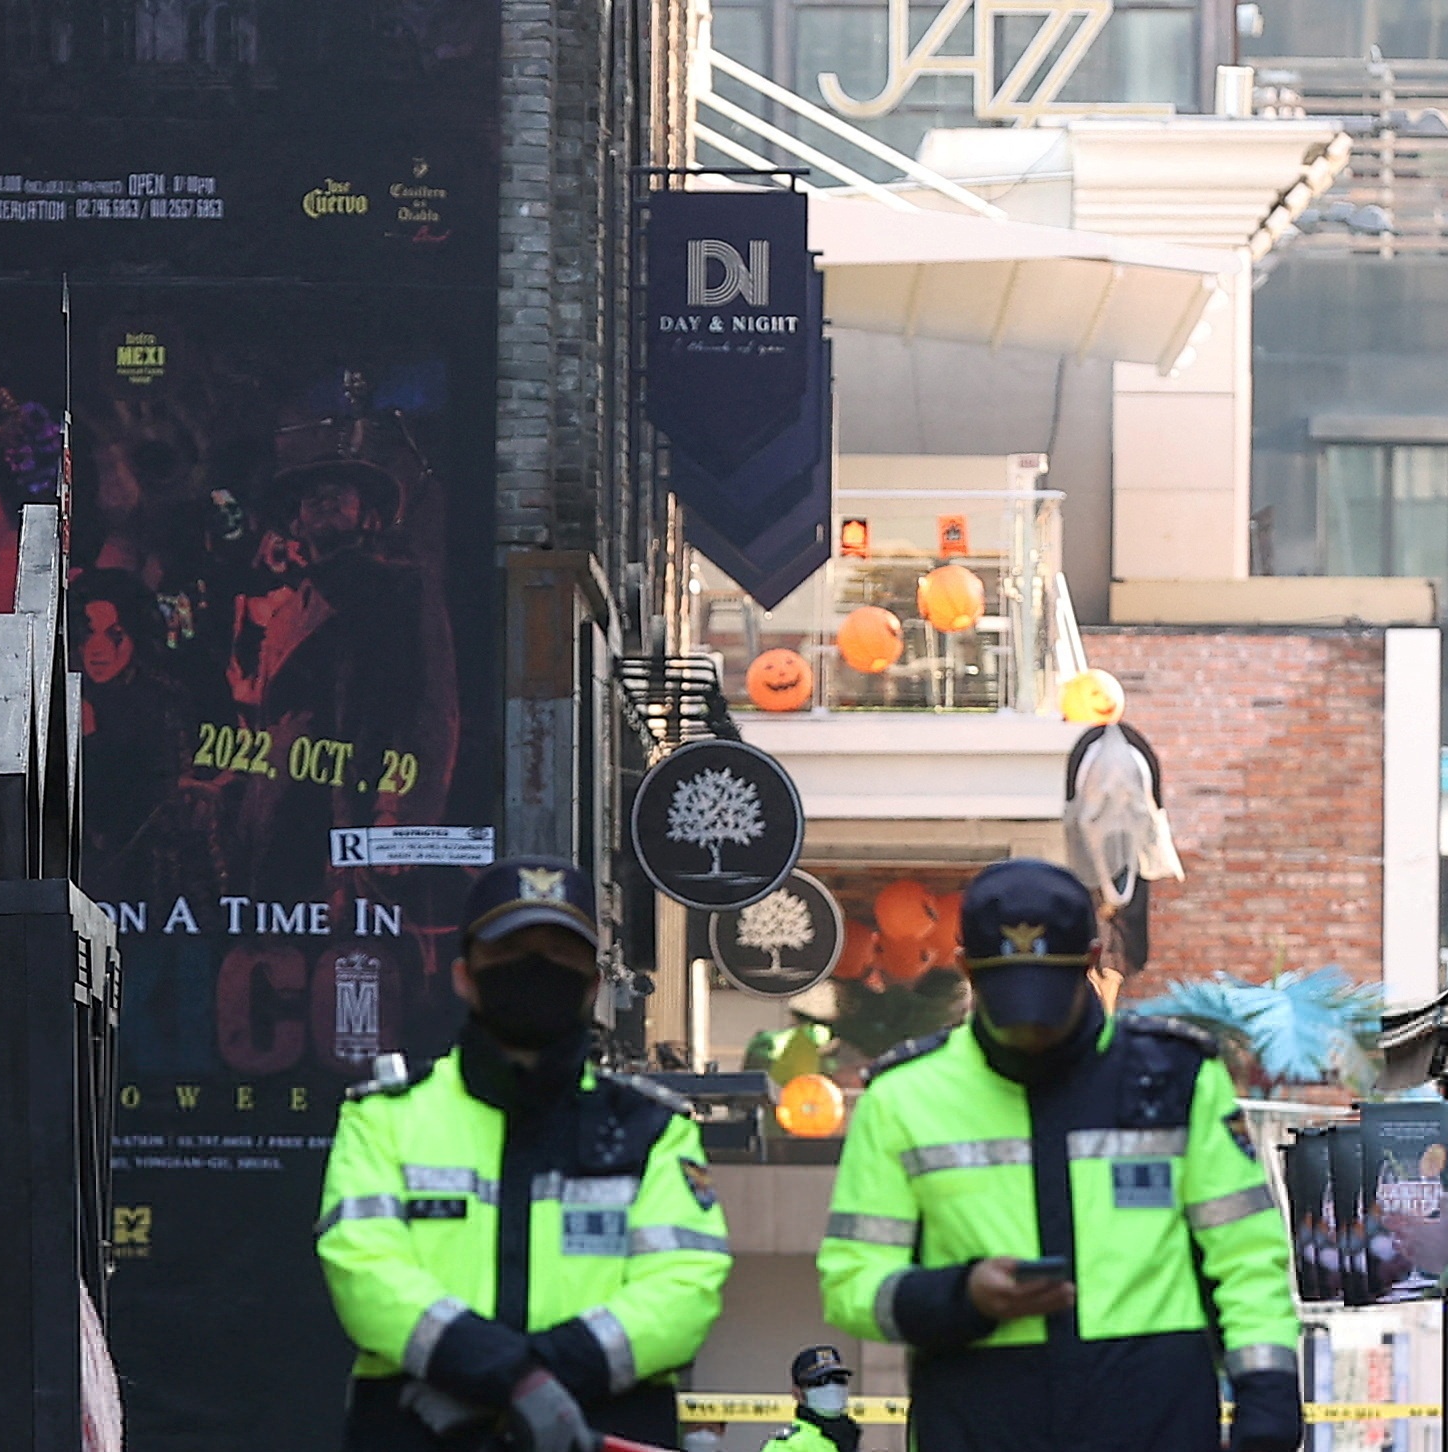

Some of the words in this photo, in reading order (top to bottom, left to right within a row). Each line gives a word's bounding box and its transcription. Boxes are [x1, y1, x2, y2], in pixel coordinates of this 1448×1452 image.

[303, 188, 368, 219] Cuervo
[660, 316, 701, 332] DAY
[709, 315, 724, 333] &
[733, 316, 799, 333] NIGHT
[377, 750, 419, 796] 29
[338, 832, 364, 862] R
[162, 896, 201, 934] A
[219, 896, 331, 935] TIME
[354, 897, 402, 936] IN
